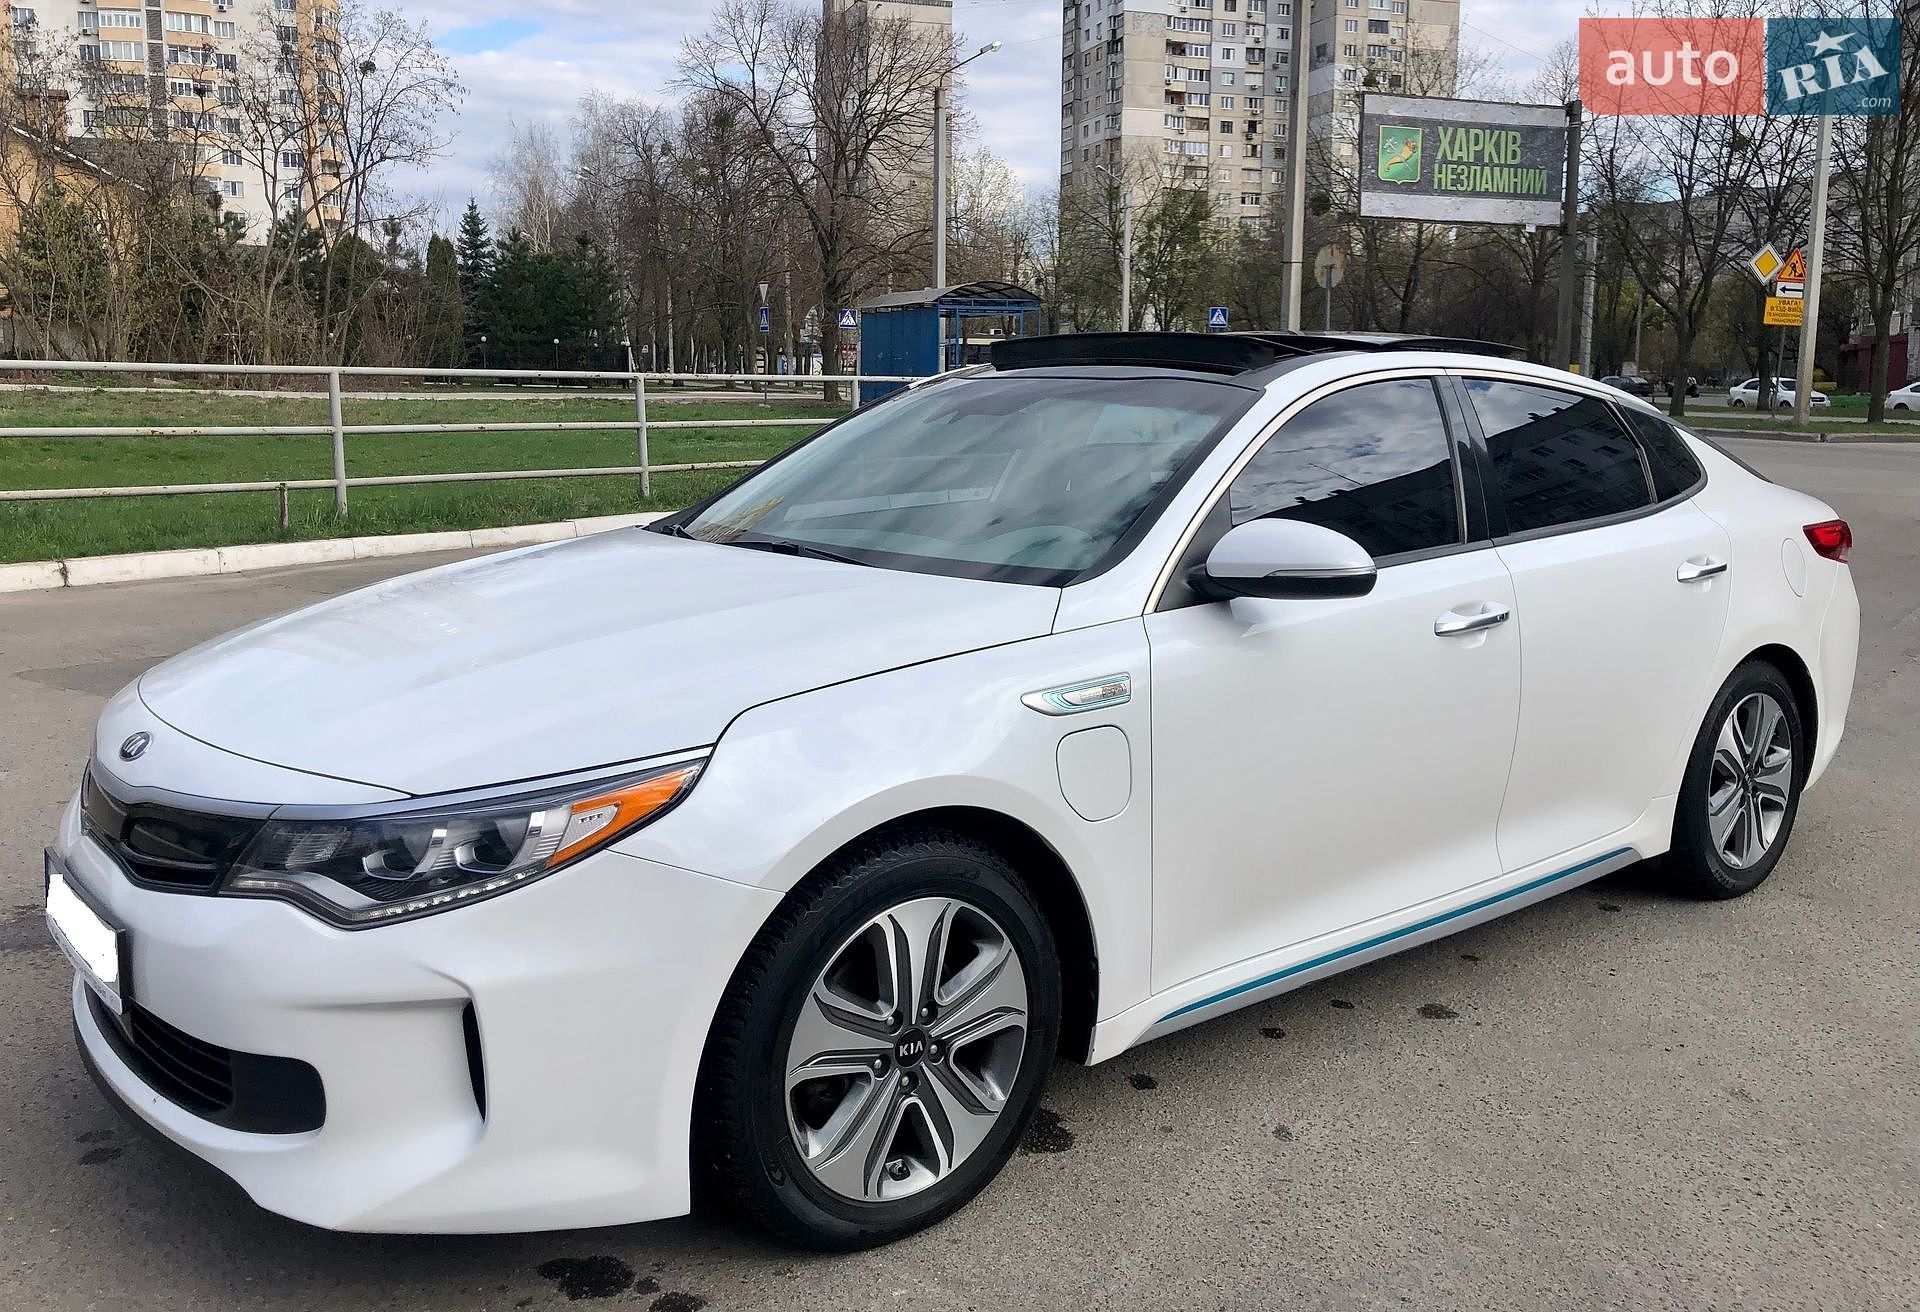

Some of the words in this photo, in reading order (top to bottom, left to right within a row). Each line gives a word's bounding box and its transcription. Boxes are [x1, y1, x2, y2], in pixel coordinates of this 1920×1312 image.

[1435, 125, 1522, 165] ХАРКІВ
[1433, 163, 1548, 195] НЕЗЛАМНИЙ
[899, 1040, 924, 1057] KIA
